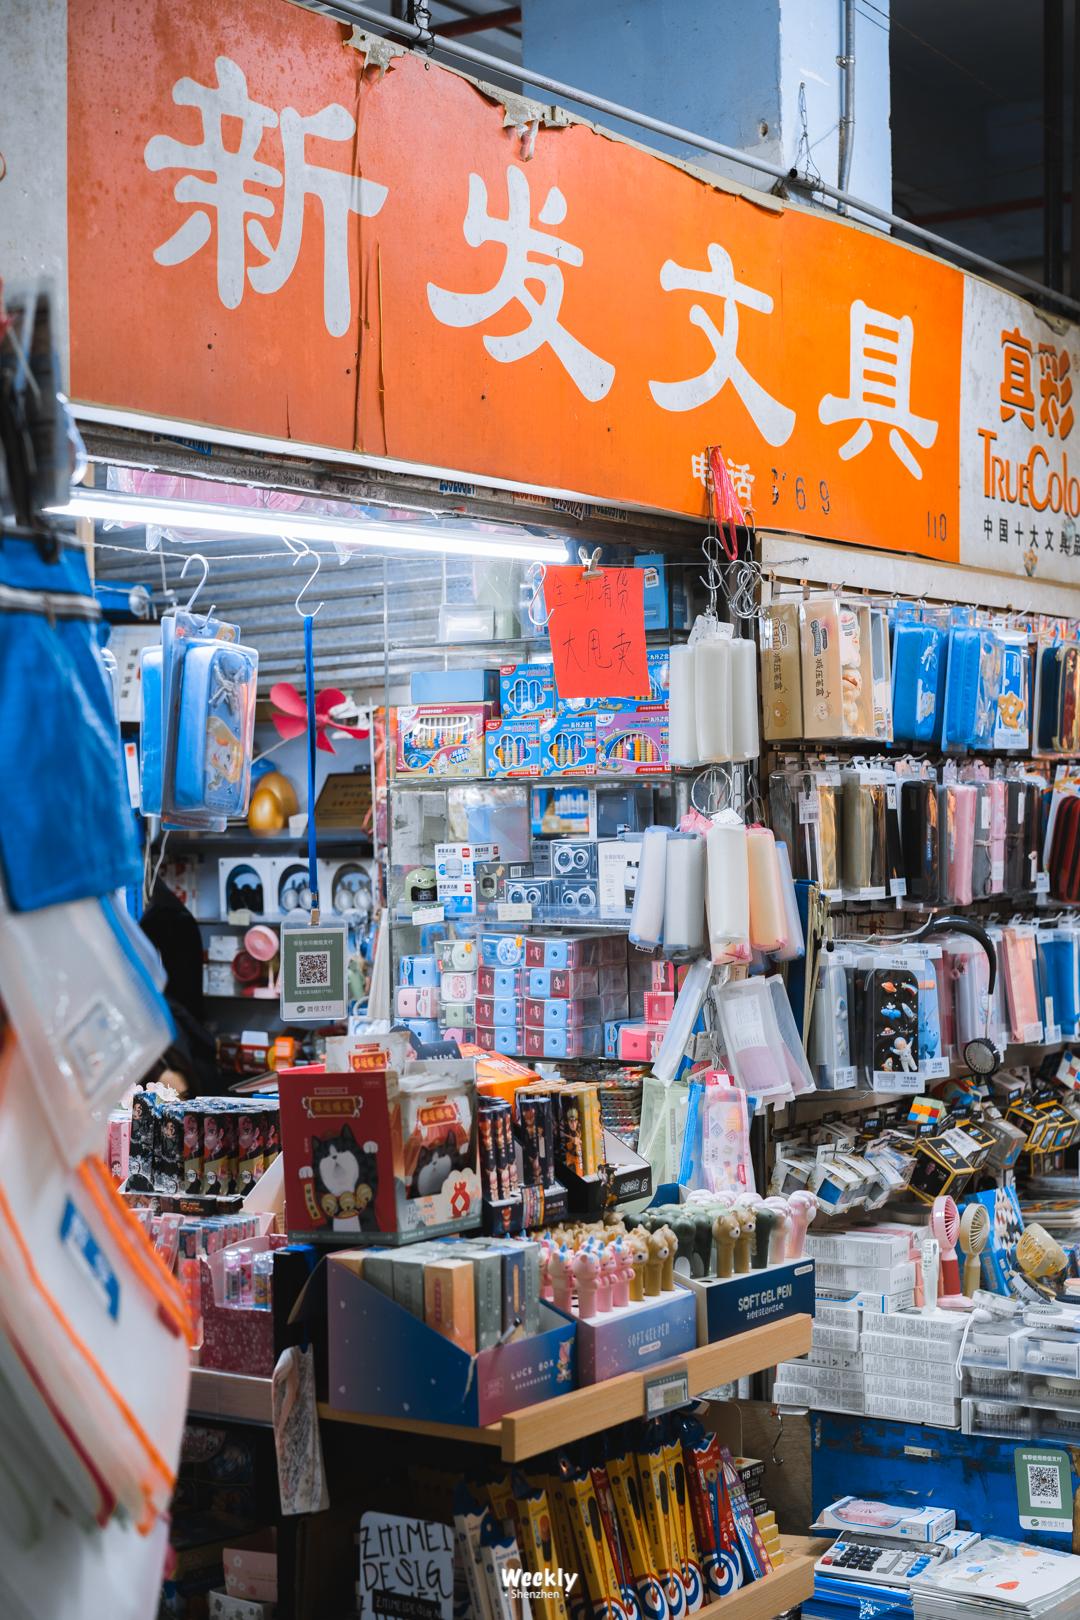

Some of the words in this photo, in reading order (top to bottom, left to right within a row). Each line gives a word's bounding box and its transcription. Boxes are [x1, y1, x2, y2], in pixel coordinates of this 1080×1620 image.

[144, 55, 939, 483] 新发文具
[1000, 327, 1075, 441] 真彩
[562, 627, 635, 676] 大甩卖
[738, 1293, 760, 1312] SOFT
[761, 1289, 776, 1306] GEL
[776, 1284, 792, 1302] PEN
